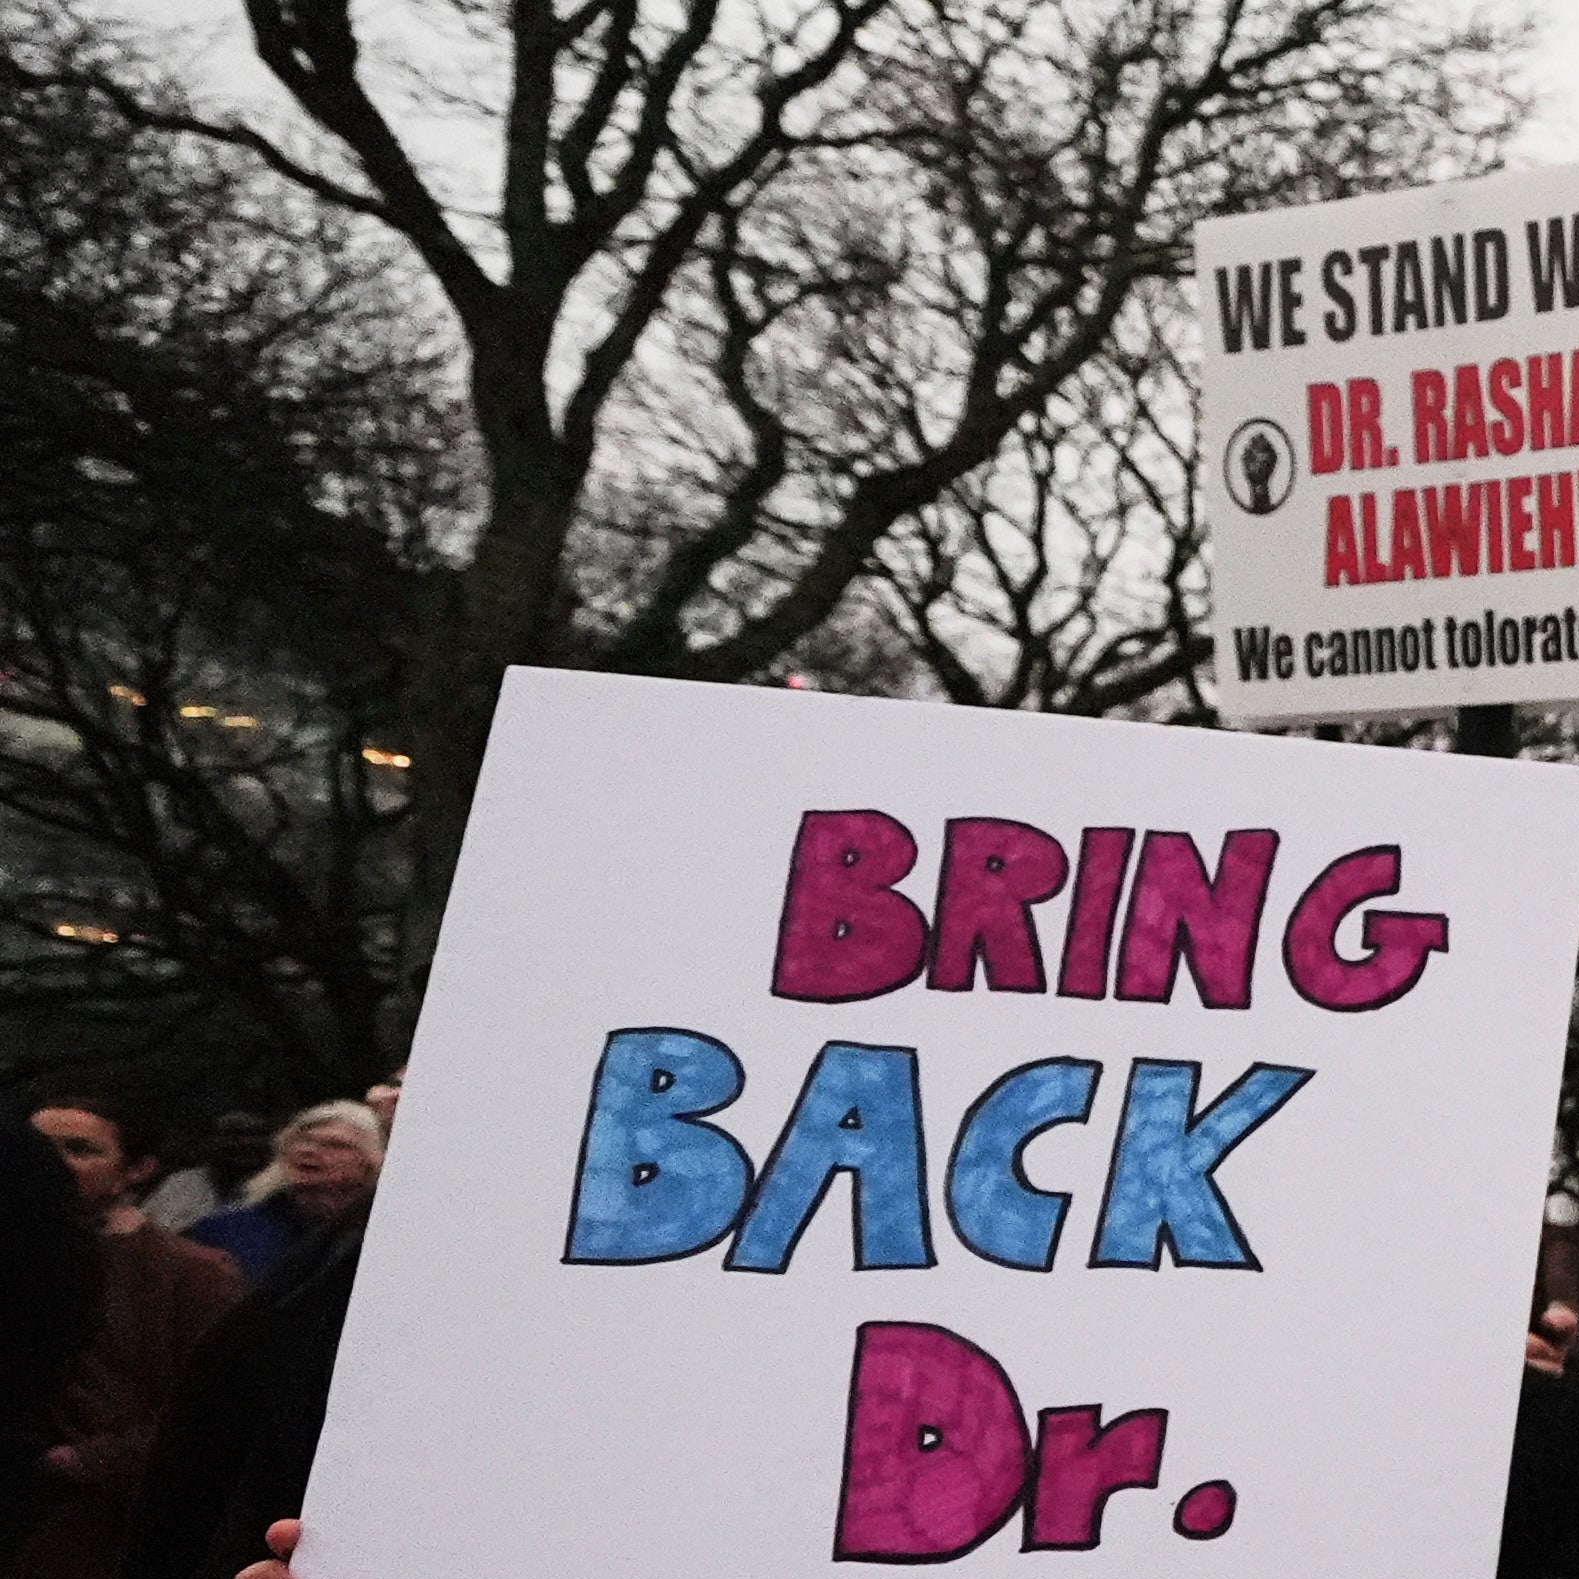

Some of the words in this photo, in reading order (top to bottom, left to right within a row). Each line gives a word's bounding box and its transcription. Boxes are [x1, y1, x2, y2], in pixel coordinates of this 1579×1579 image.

[1216, 257, 1306, 353] WE
[1321, 228, 1509, 342] STAND
[1307, 377, 1399, 476] DR.
[1234, 626, 1293, 681] We
[1306, 618, 1436, 677] cannot
[771, 808, 1449, 1012] BRING
[560, 1027, 1316, 1274] BACK
[832, 1320, 1237, 1564] Dr.
